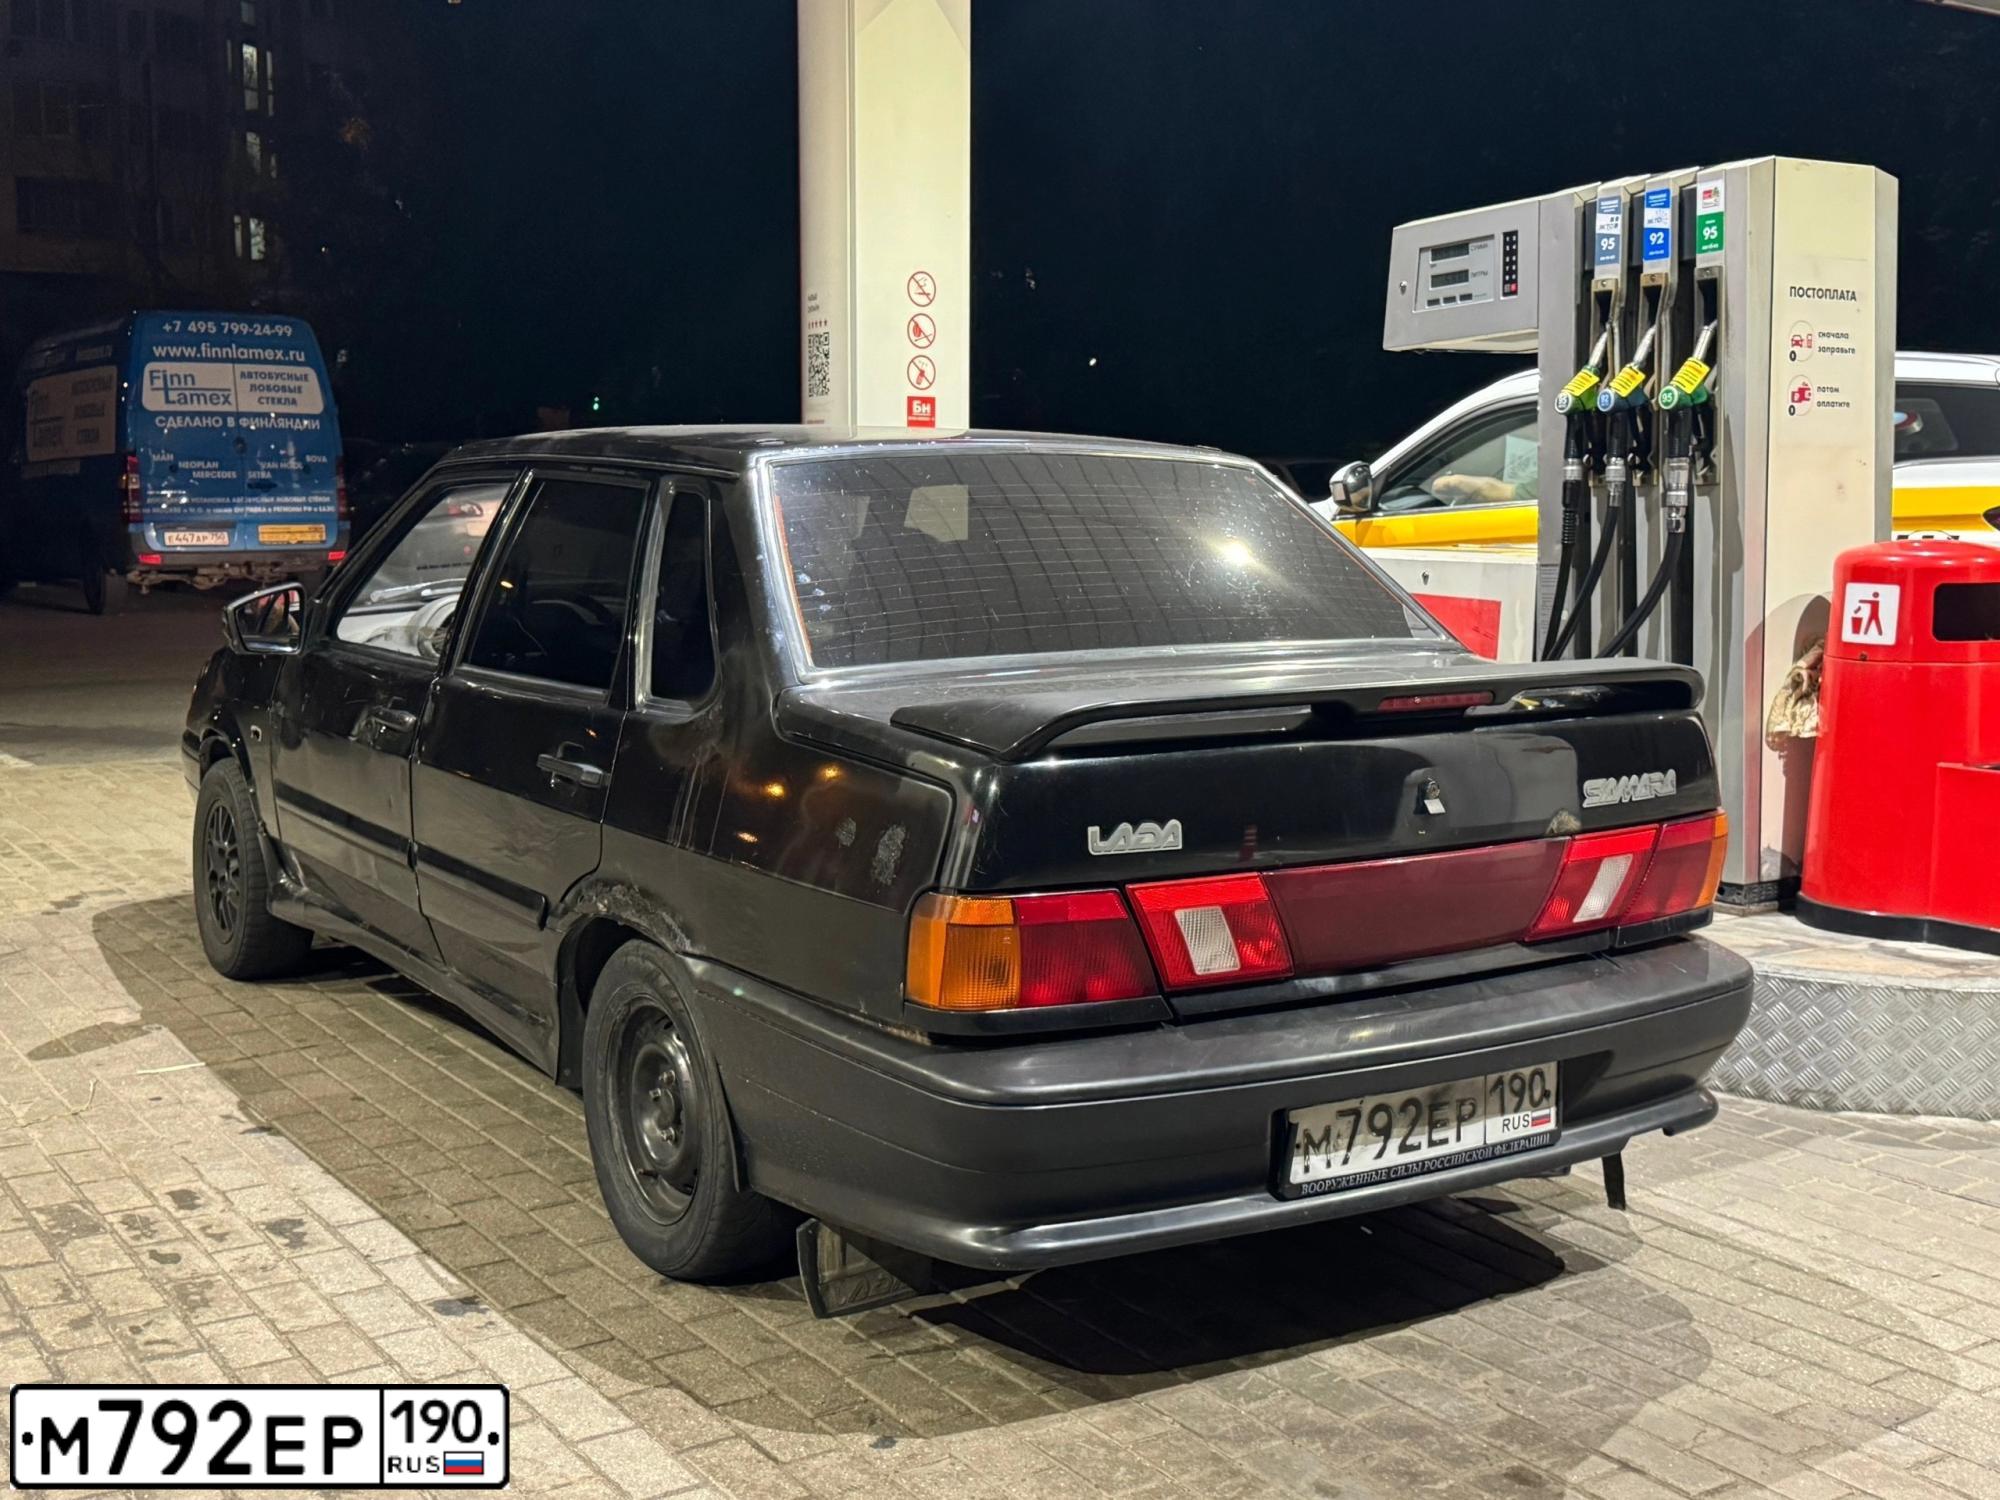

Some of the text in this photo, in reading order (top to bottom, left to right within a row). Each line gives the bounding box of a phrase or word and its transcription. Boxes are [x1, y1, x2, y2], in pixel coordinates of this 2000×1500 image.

[1649, 232, 1664, 245] 92
[1702, 225, 1718, 241] 95
[1600, 237, 1615, 250] 95
[1789, 286, 1857, 301] ПОСТОПЛАТА
[162, 320, 293, 337] +7 495 799-24-99
[1818, 331, 1849, 339] сначала
[152, 342, 306, 362] www.finnlamex.ru
[1818, 346, 1856, 356] заправьте
[149, 369, 196, 387] Finn
[240, 371, 309, 382] АВТОБУСНЫЕ
[249, 383, 303, 394] ЛОБОВЫЕ
[1816, 385, 1840, 393] потом
[164, 388, 233, 406] Lamex
[257, 396, 298, 407] СТЕКЛА
[1661, 392, 1673, 403] 95
[1816, 401, 1850, 409] оплатите
[155, 416, 321, 431] СДЕЛАНО В ФИНЛЯНДИИ
[178, 461, 219, 469] NEOPLAN
[192, 471, 238, 479] MERCEDES
[1582, 768, 1677, 808] SAMARA
[1087, 819, 1183, 856] LADA
[1303, 1067, 1546, 1174] М792ЕР 190
[1502, 1113, 1531, 1134] RUS
[1301, 1133, 1551, 1196] ВООРУЖЕННЫЕ СИЛЫ РОССИЙСКОЙ ФЕДЕРАЦИИ
